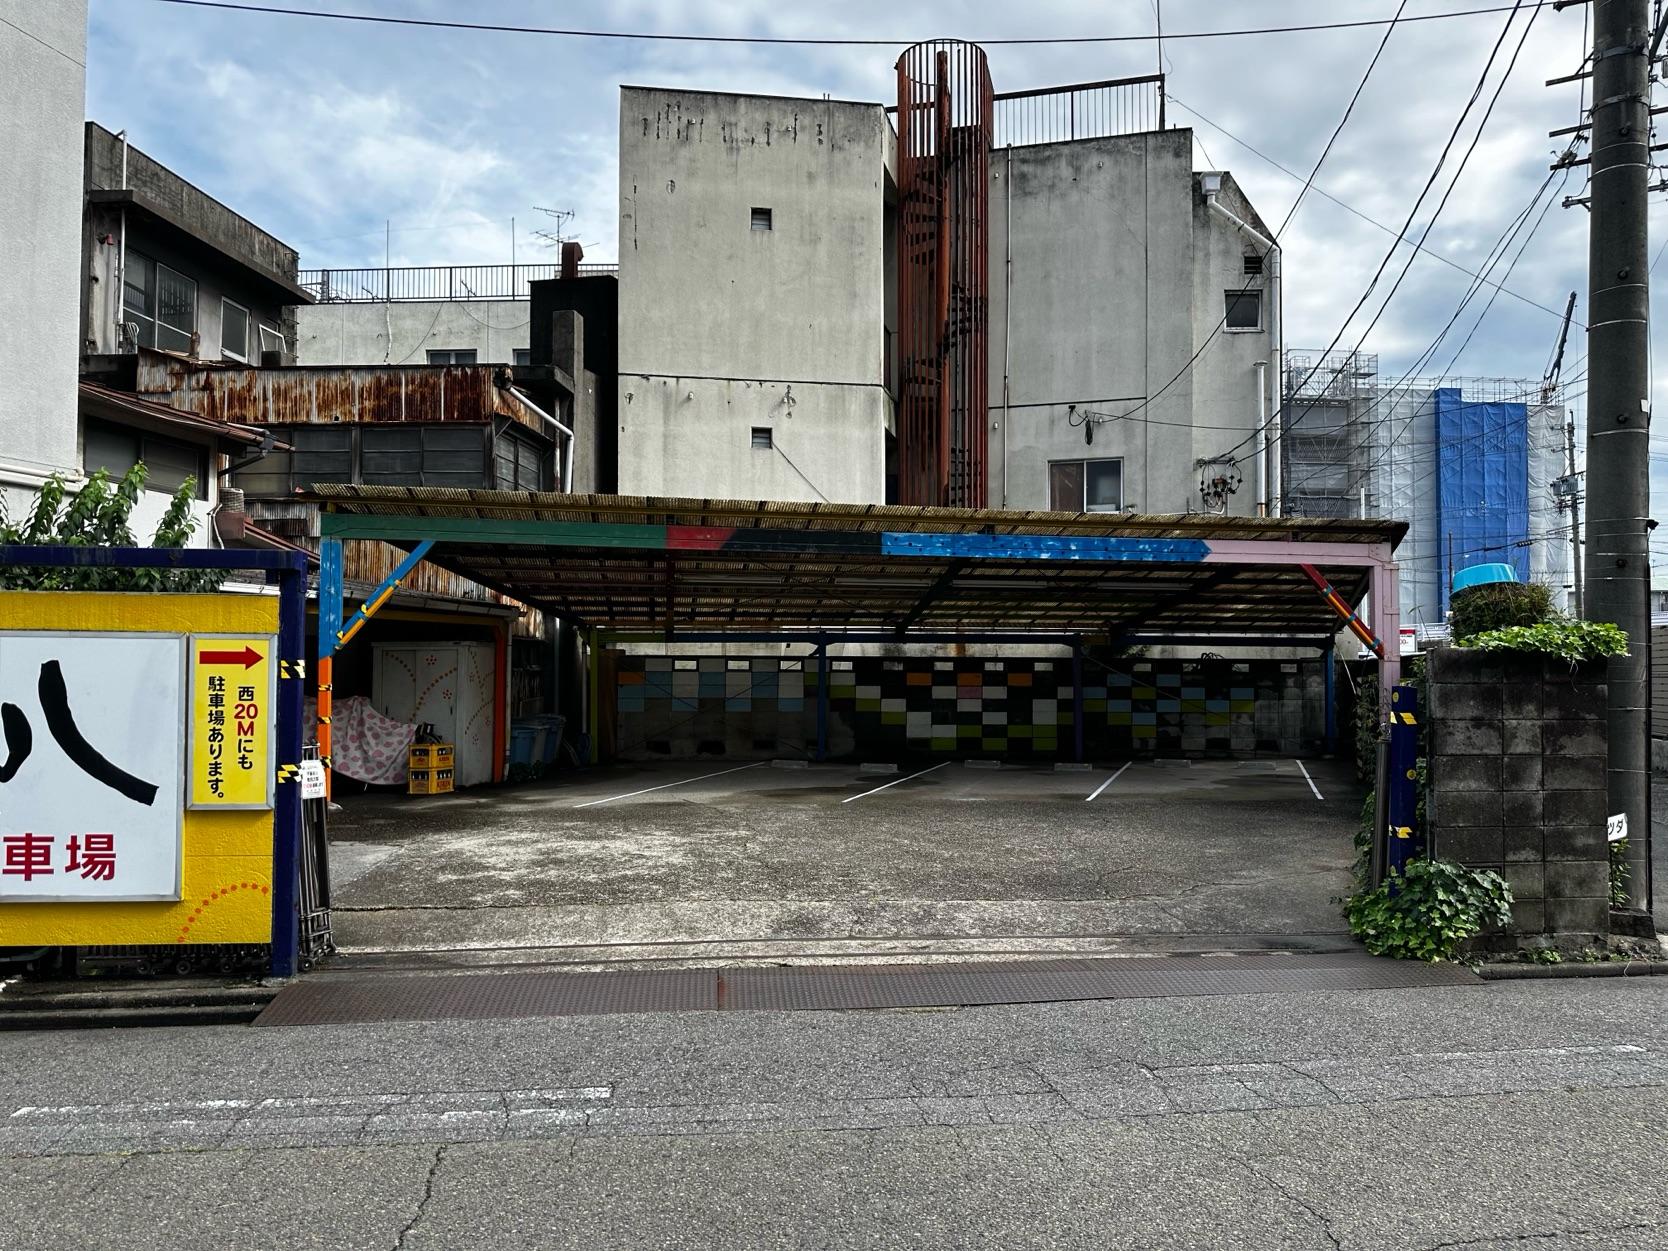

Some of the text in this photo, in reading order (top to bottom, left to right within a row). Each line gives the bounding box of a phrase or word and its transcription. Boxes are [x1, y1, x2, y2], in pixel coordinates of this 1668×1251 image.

[207, 676, 226, 799] 駐車場あります。
[233, 686, 259, 771] 西20Mにも
[2, 833, 117, 881] 車場
